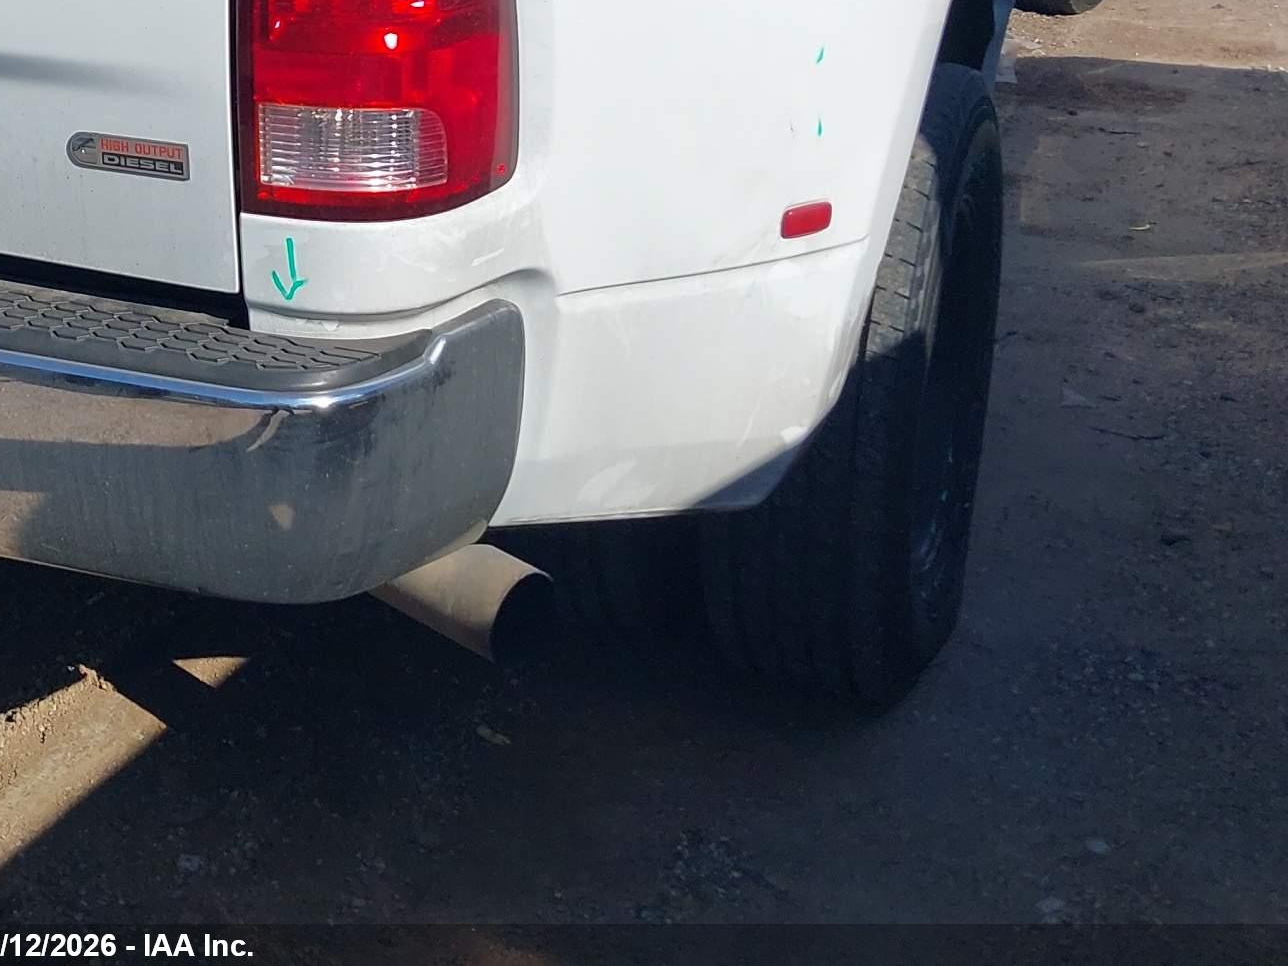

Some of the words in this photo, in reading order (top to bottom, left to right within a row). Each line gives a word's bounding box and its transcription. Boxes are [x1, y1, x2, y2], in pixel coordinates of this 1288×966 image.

[100, 137, 129, 153] HIGH
[135, 143, 183, 160] OUTPUT
[103, 154, 183, 174] DIESEL
